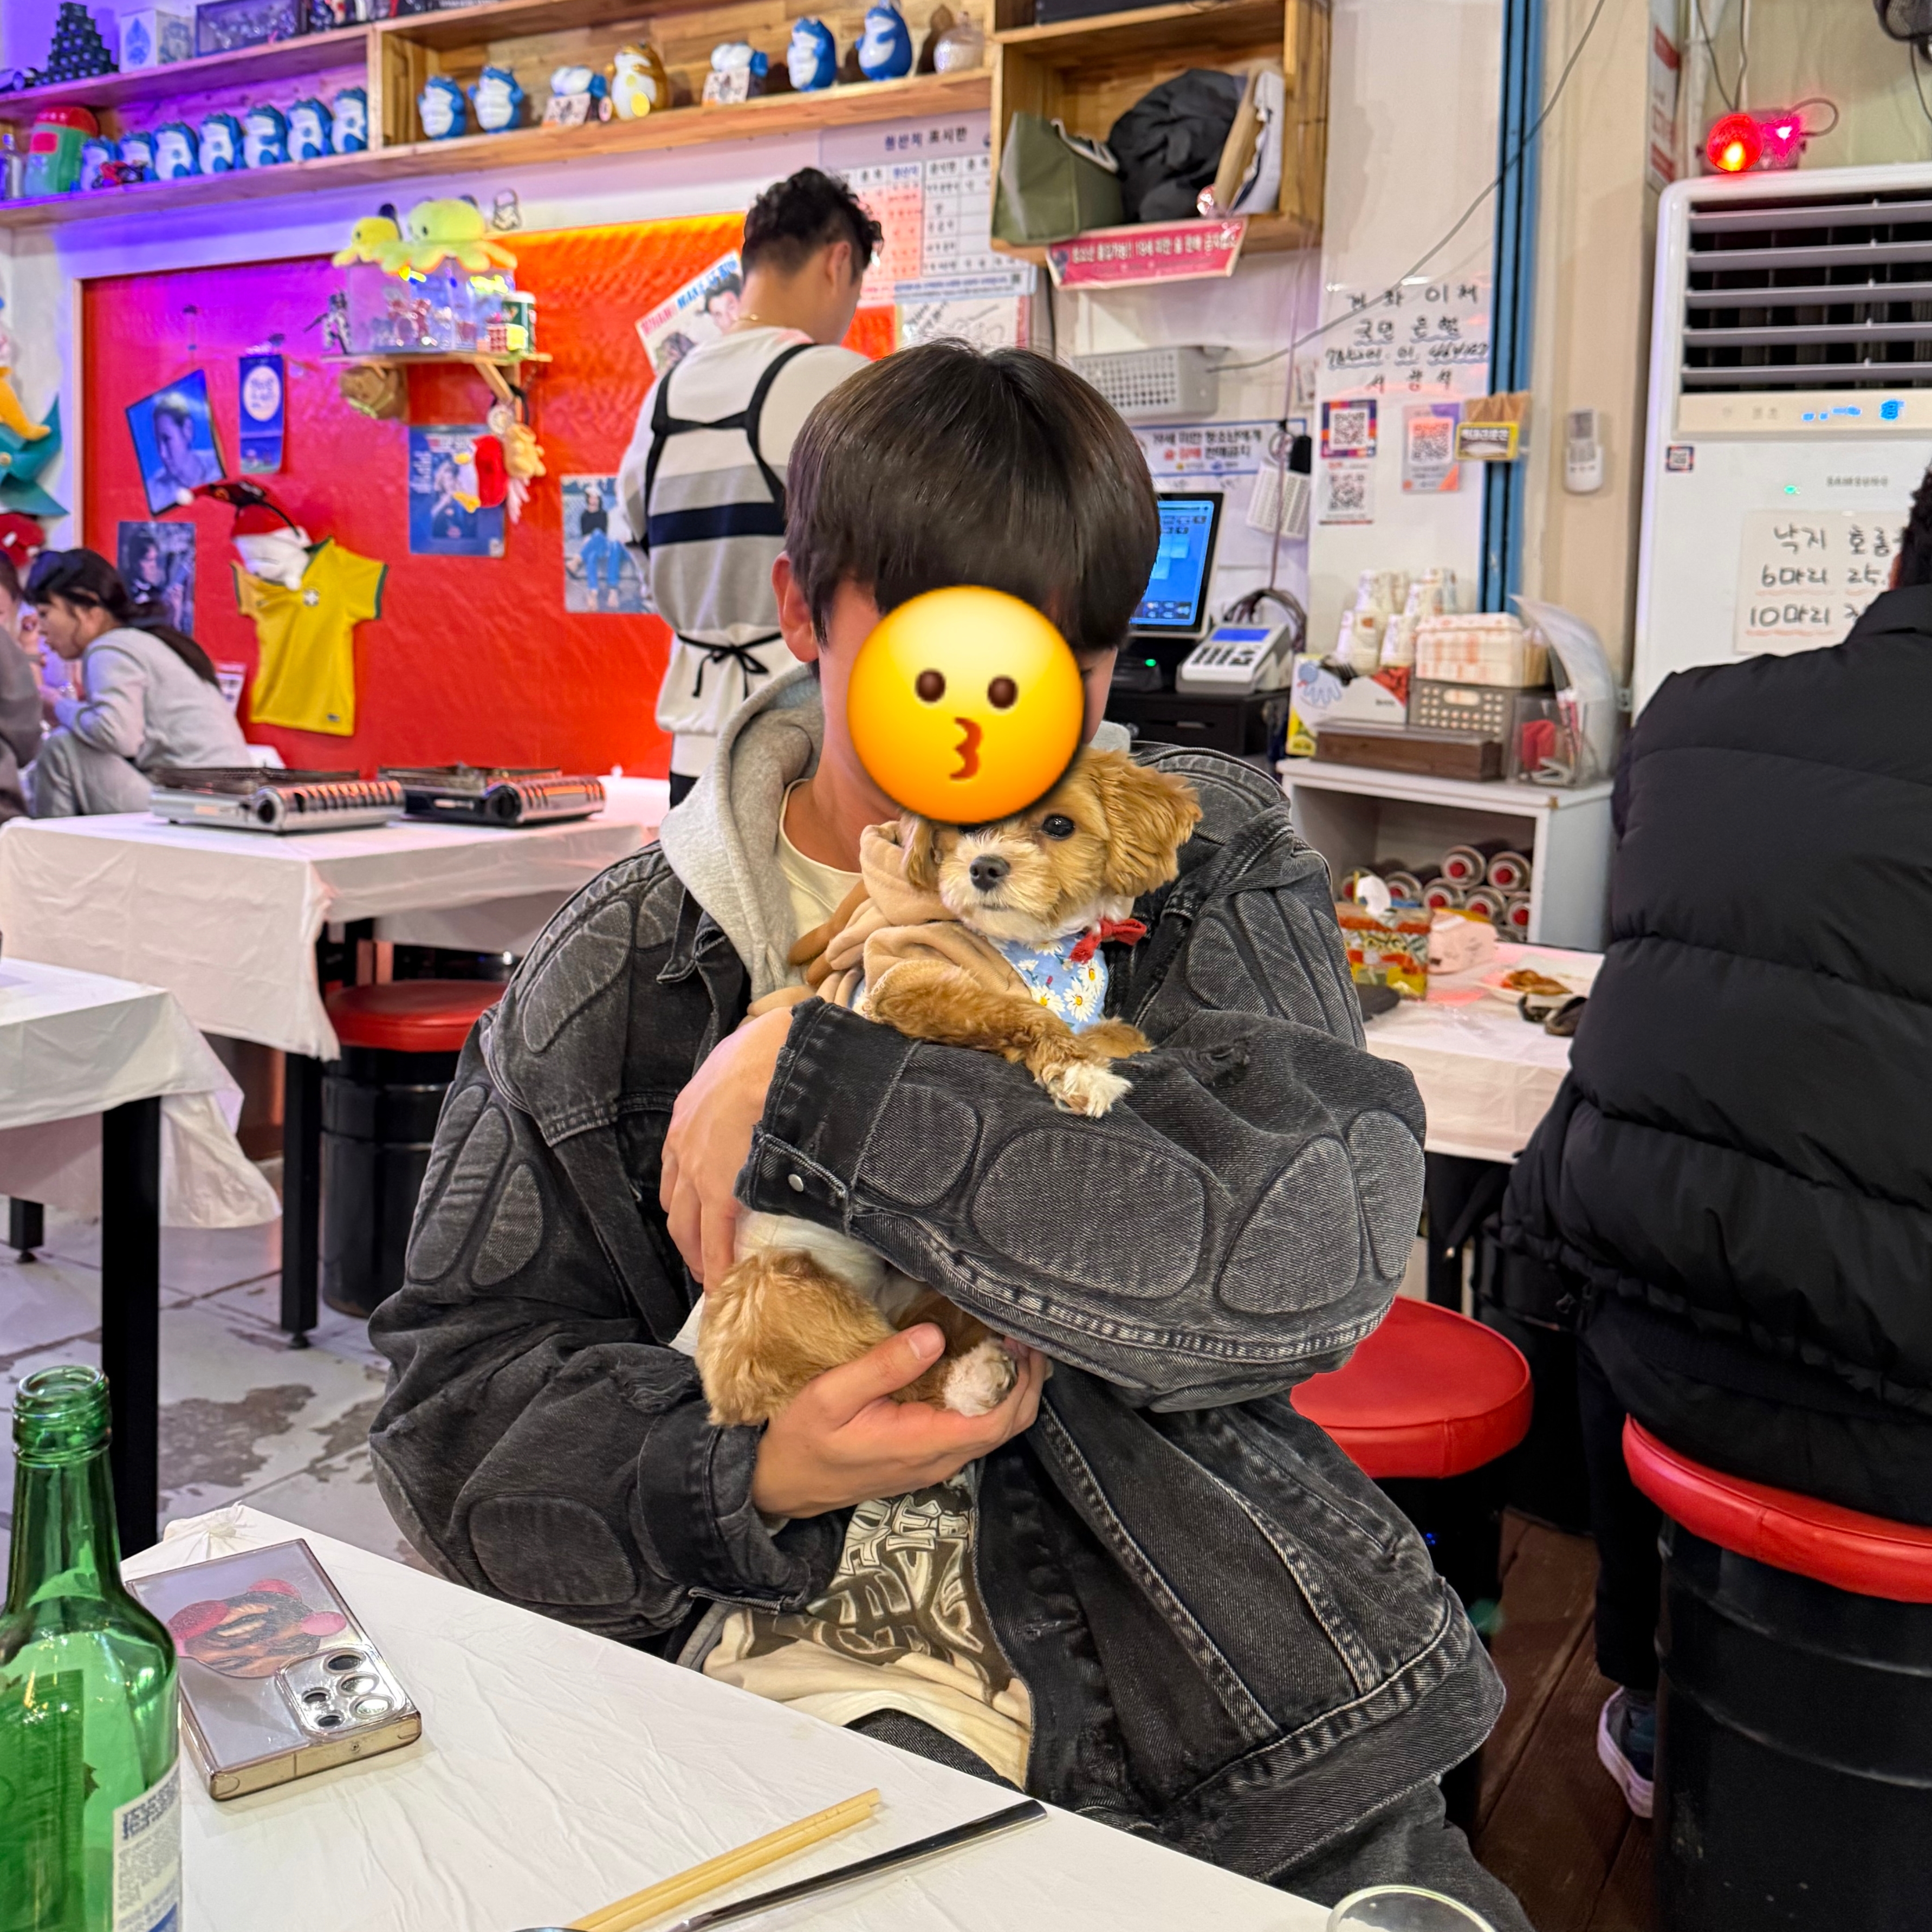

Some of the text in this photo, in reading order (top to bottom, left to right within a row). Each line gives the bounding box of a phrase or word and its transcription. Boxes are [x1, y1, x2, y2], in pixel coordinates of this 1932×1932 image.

[1826, 475, 1889, 488] SAMSUNG
[1773, 523, 1826, 555] 낙지
[1762, 563, 1827, 587] 6마리
[1750, 603, 1830, 627] 10마리
